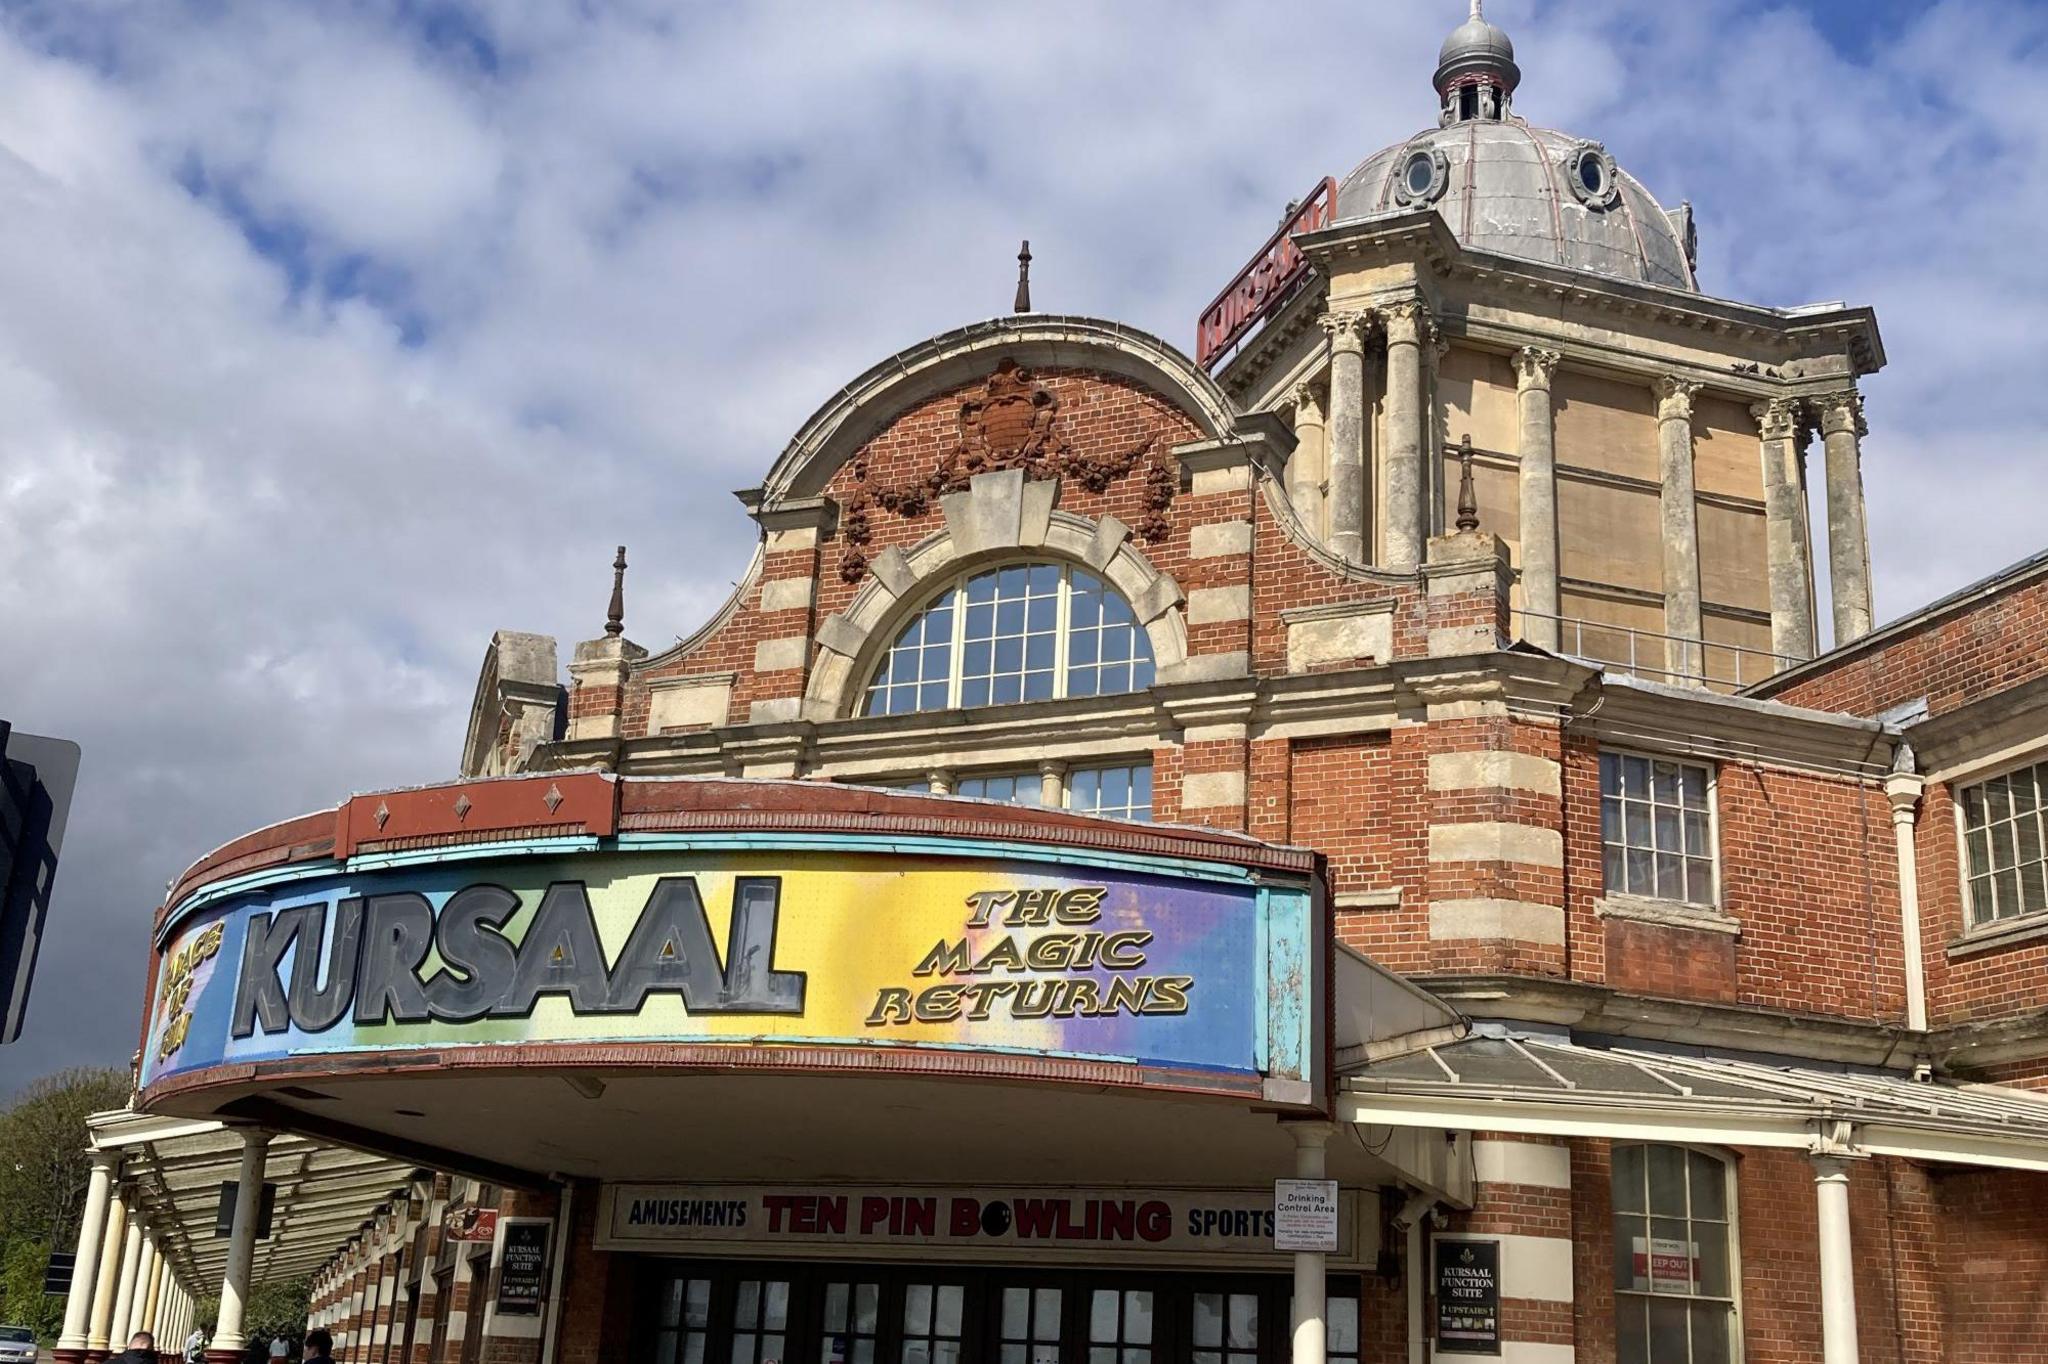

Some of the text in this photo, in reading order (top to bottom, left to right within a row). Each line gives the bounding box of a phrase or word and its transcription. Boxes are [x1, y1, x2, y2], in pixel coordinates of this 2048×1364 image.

[966, 887, 1108, 927] THE
[232, 876, 807, 1039] KURSAAL
[912, 931, 1154, 976] MAGIC
[864, 975, 1195, 1026] RETURNS
[1288, 1194, 1325, 1203] Drinking
[1277, 1203, 1335, 1213] Control Area
[628, 1200, 748, 1228] AMUSEMENTS
[762, 1195, 1172, 1242] TEN PIN BOWLING
[1188, 1208, 1274, 1237] SPORTS
[508, 1246, 540, 1254] KURSAAL
[506, 1254, 541, 1262] FUNCTION
[512, 1262, 534, 1270] SUITE
[1444, 1267, 1491, 1277] KURSAAL
[1441, 1277, 1493, 1288] FUNCTION
[1452, 1288, 1483, 1298] SUITE
